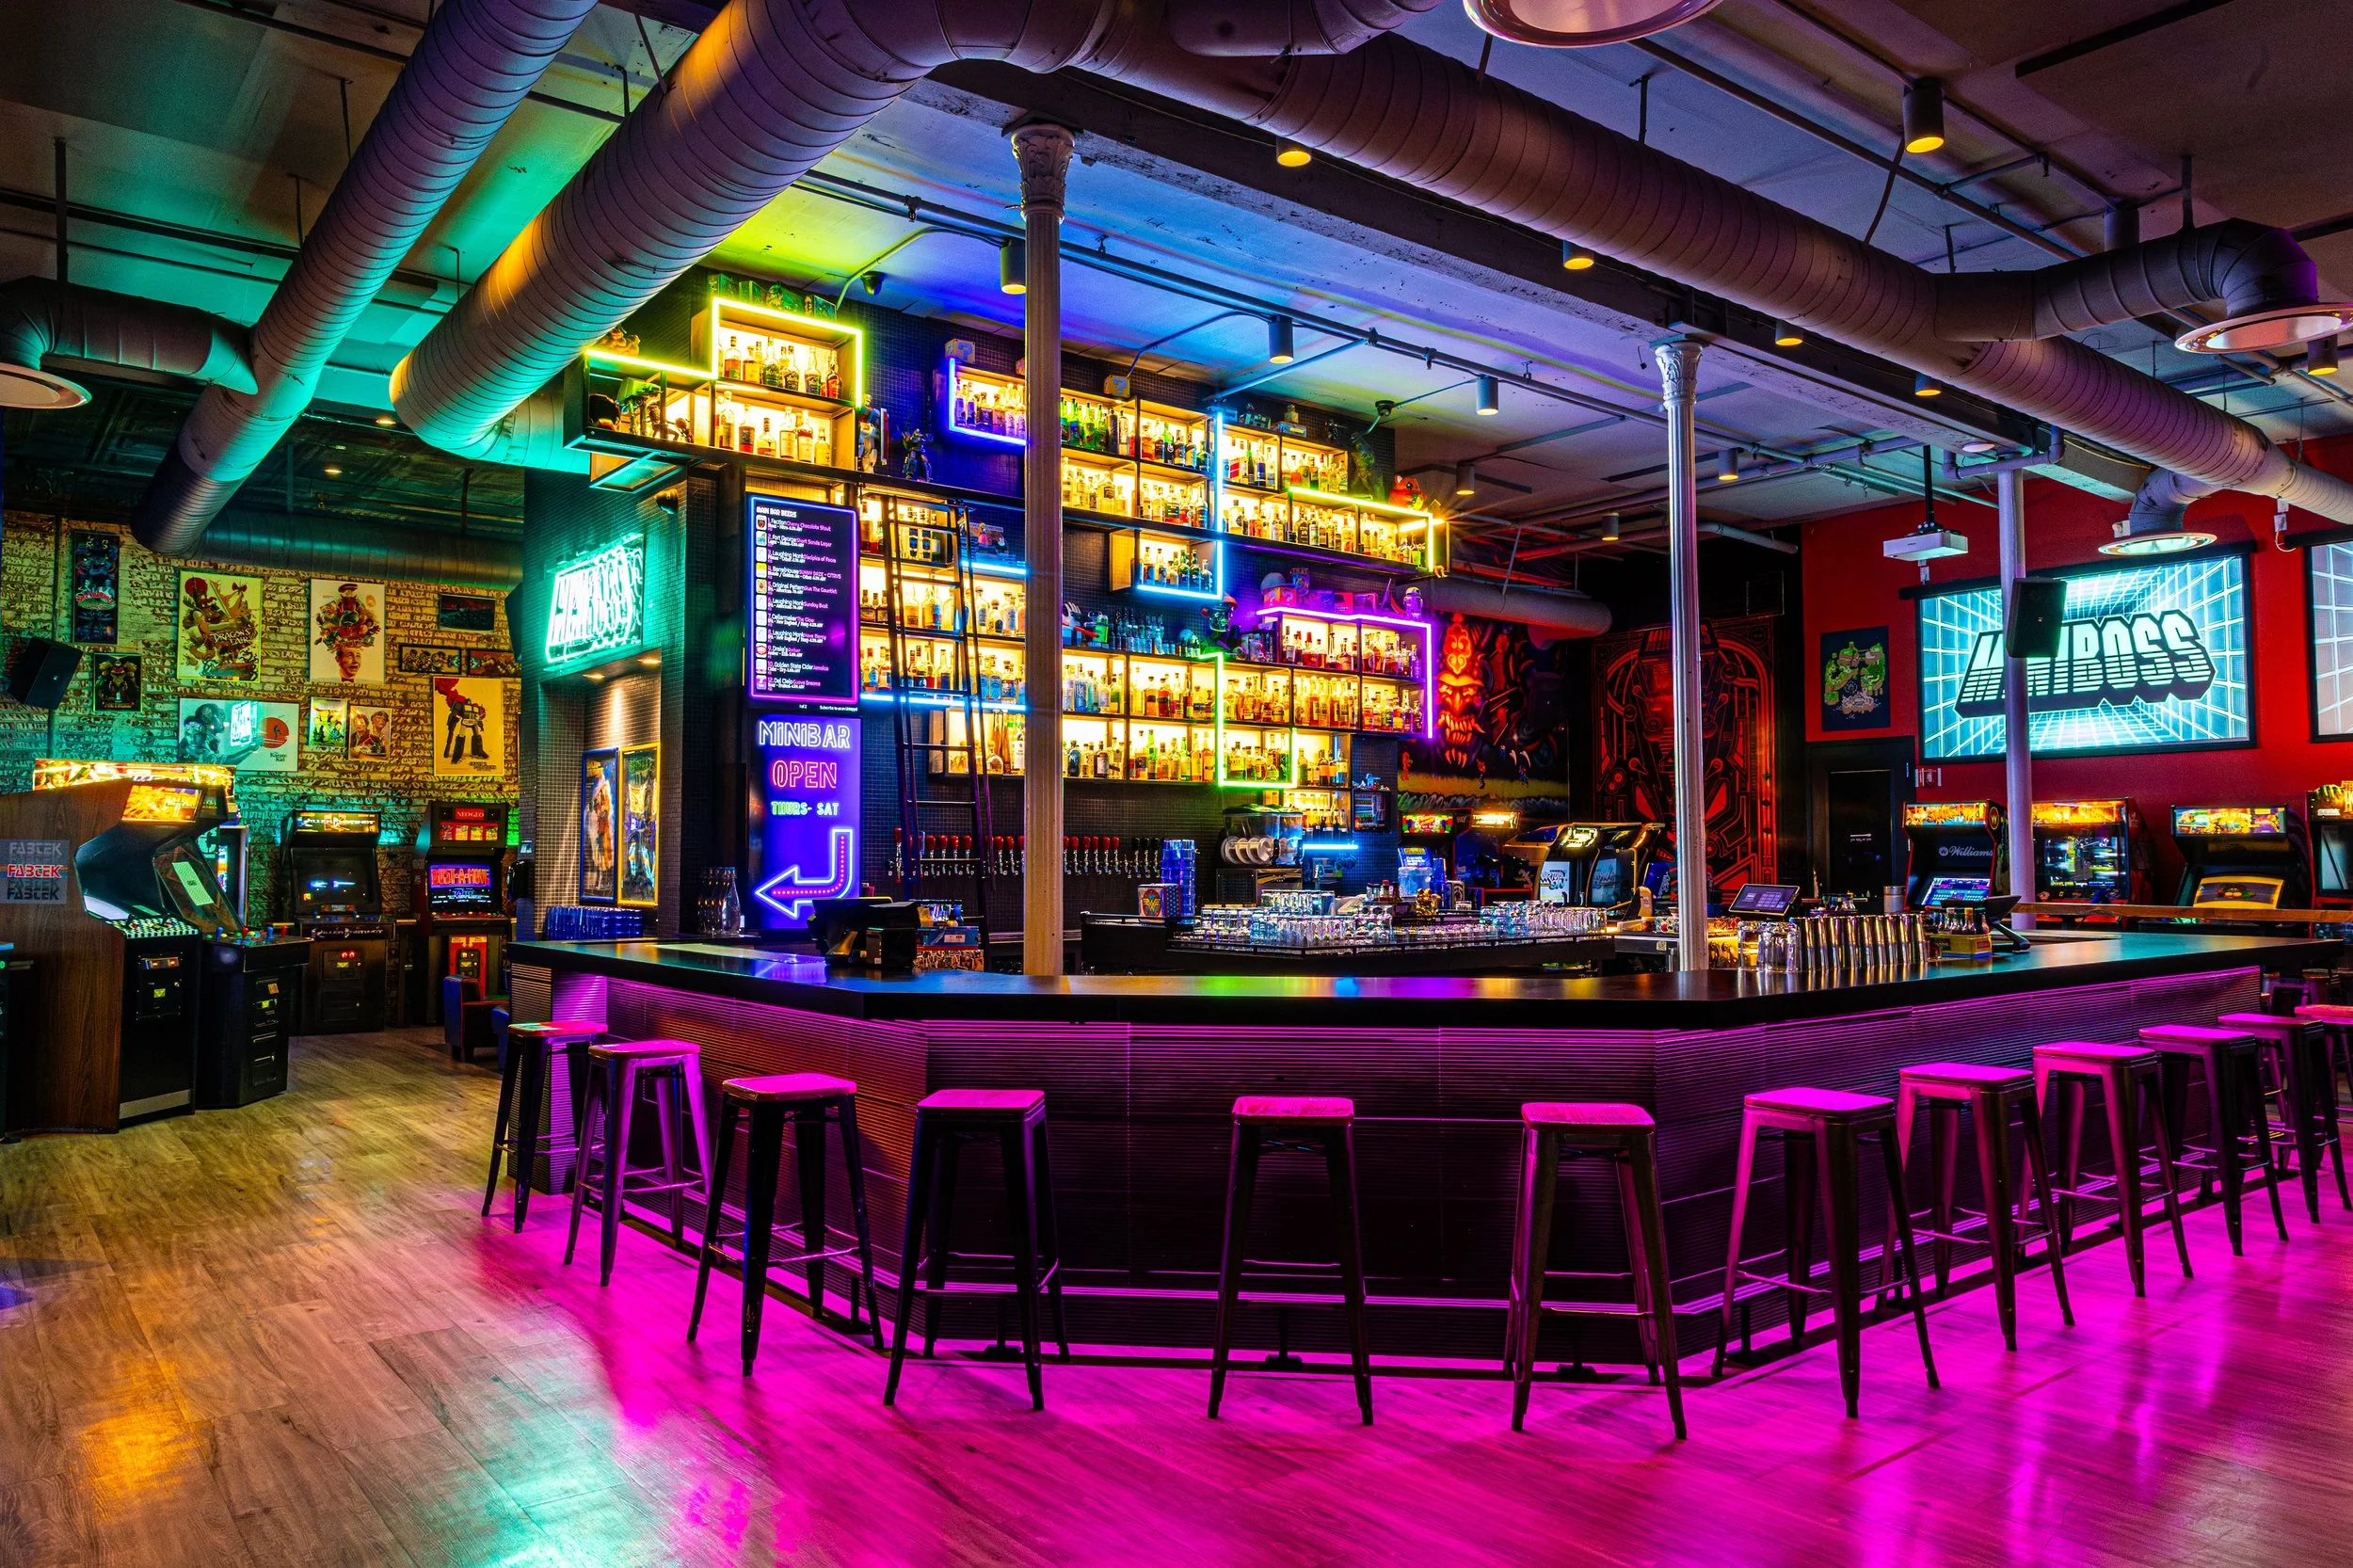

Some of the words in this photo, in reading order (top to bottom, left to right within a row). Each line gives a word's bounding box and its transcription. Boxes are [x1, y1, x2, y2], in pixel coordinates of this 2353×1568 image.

[770, 508, 780, 517] BAR
[781, 509, 797, 519] BEERS
[759, 720, 850, 748] MINIBAR
[772, 760, 837, 789] OPEN
[816, 802, 840, 816] SAT
[8, 842, 62, 856] FABTEK
[1949, 846, 1993, 857] Williams
[8, 864, 62, 878] FABTEK
[7, 887, 60, 901] FABTEK
